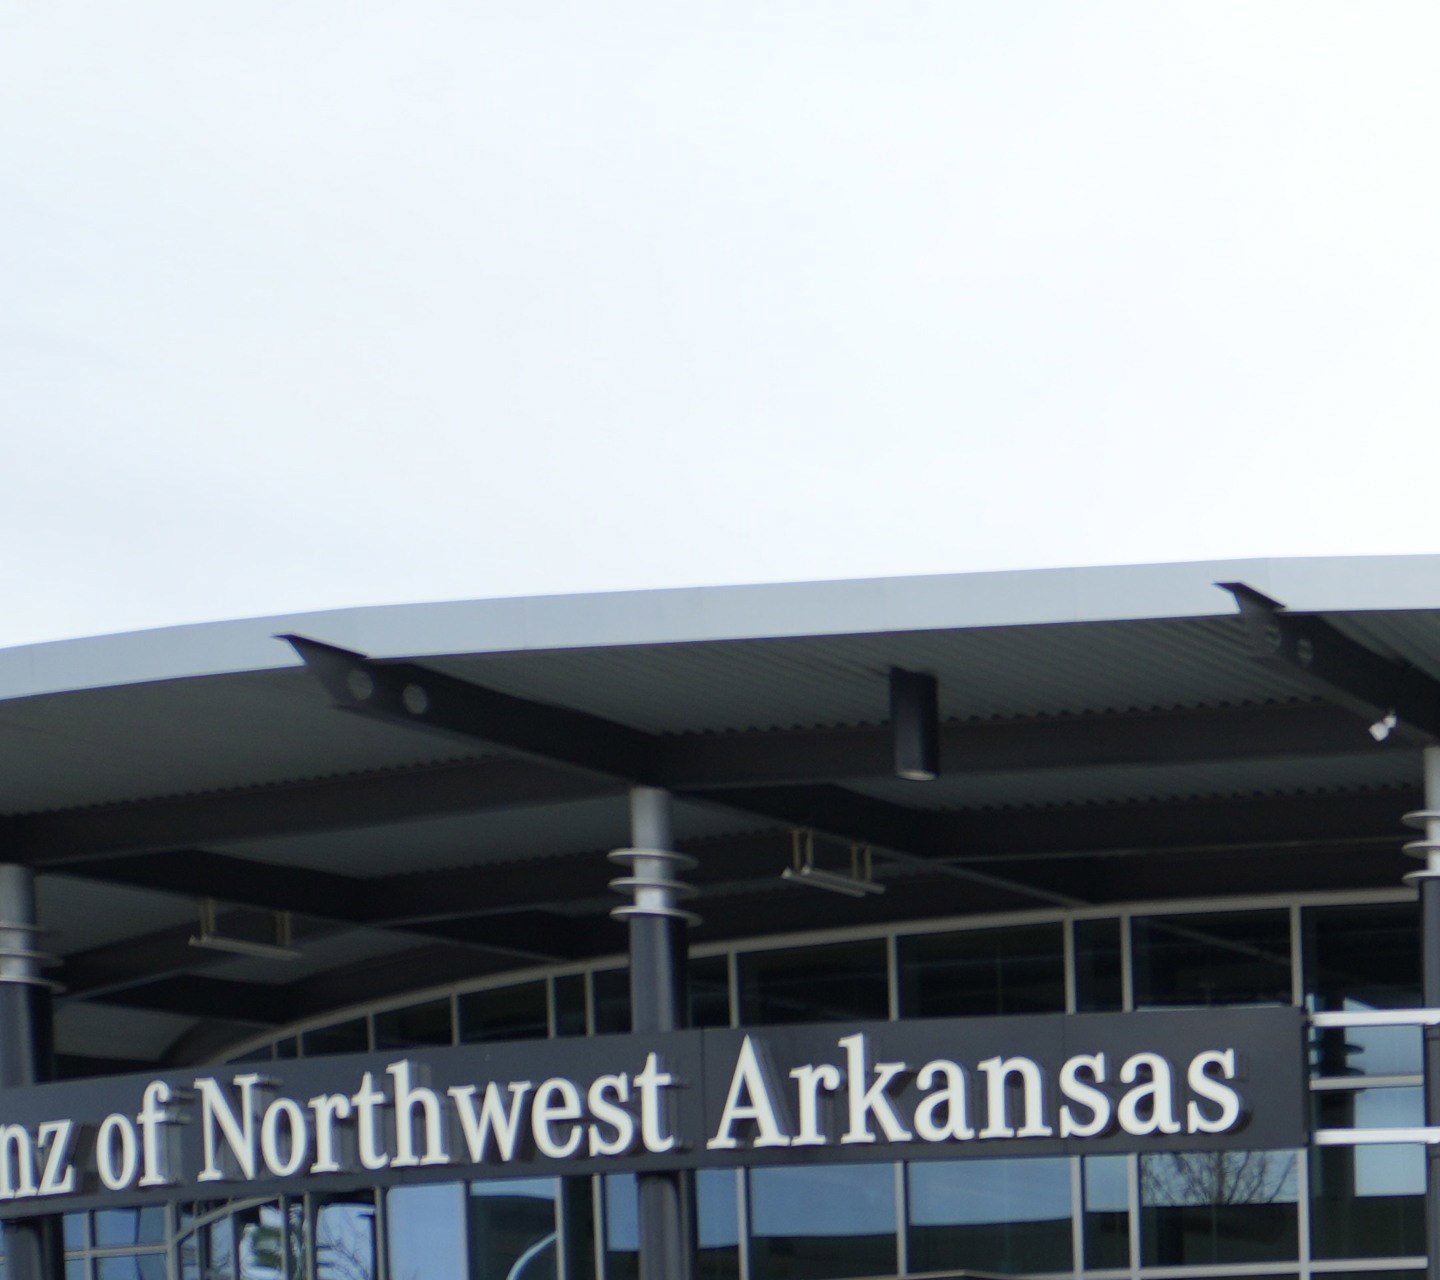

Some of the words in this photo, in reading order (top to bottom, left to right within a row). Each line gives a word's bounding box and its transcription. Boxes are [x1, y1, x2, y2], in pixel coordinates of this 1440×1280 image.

[97, 1081, 169, 1191] of
[194, 1052, 674, 1182] Northwest
[707, 1034, 1241, 1150] Arkansas
